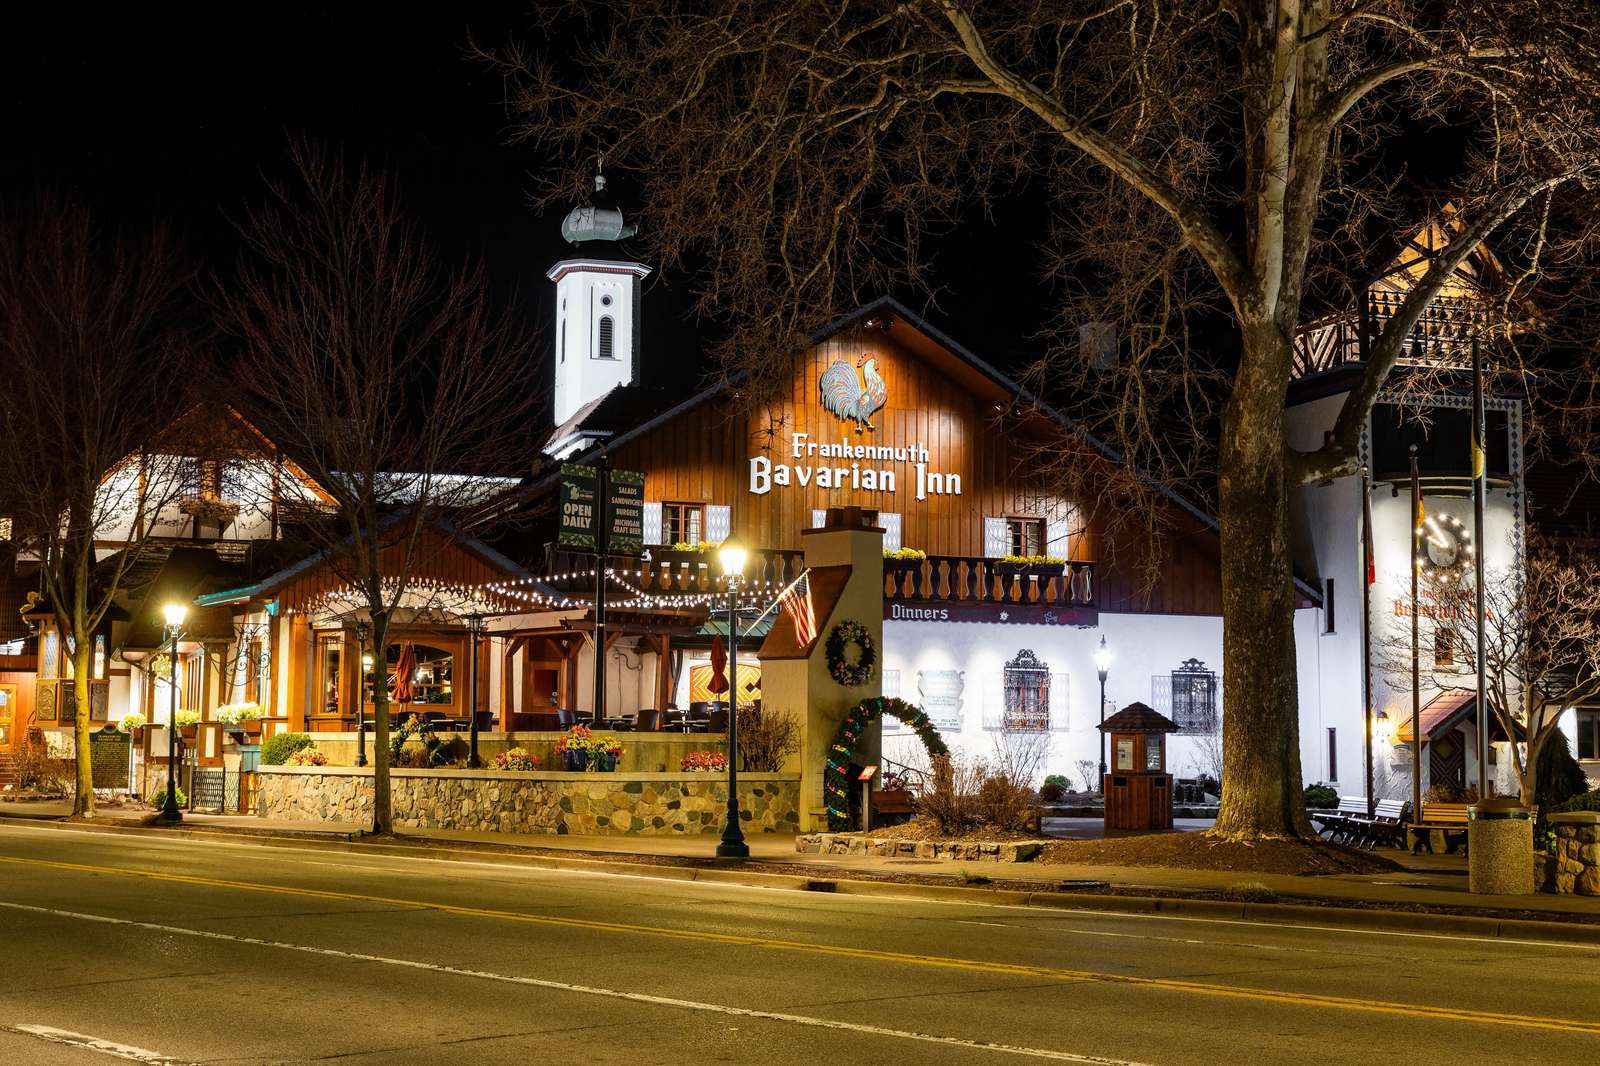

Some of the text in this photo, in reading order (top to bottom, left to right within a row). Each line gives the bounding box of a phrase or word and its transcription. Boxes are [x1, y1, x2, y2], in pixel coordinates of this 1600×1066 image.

[791, 432, 930, 463] Frankenmuth
[750, 455, 962, 501] Bavarian Inn
[618, 487, 637, 495] SALADS
[564, 503, 592, 516] OPEN
[616, 508, 639, 516] BURGERS
[563, 515, 592, 528] DAILY
[614, 519, 640, 527] MICHIGAN
[613, 526, 641, 535] CRAFT BEER
[891, 603, 949, 620] Dinners
